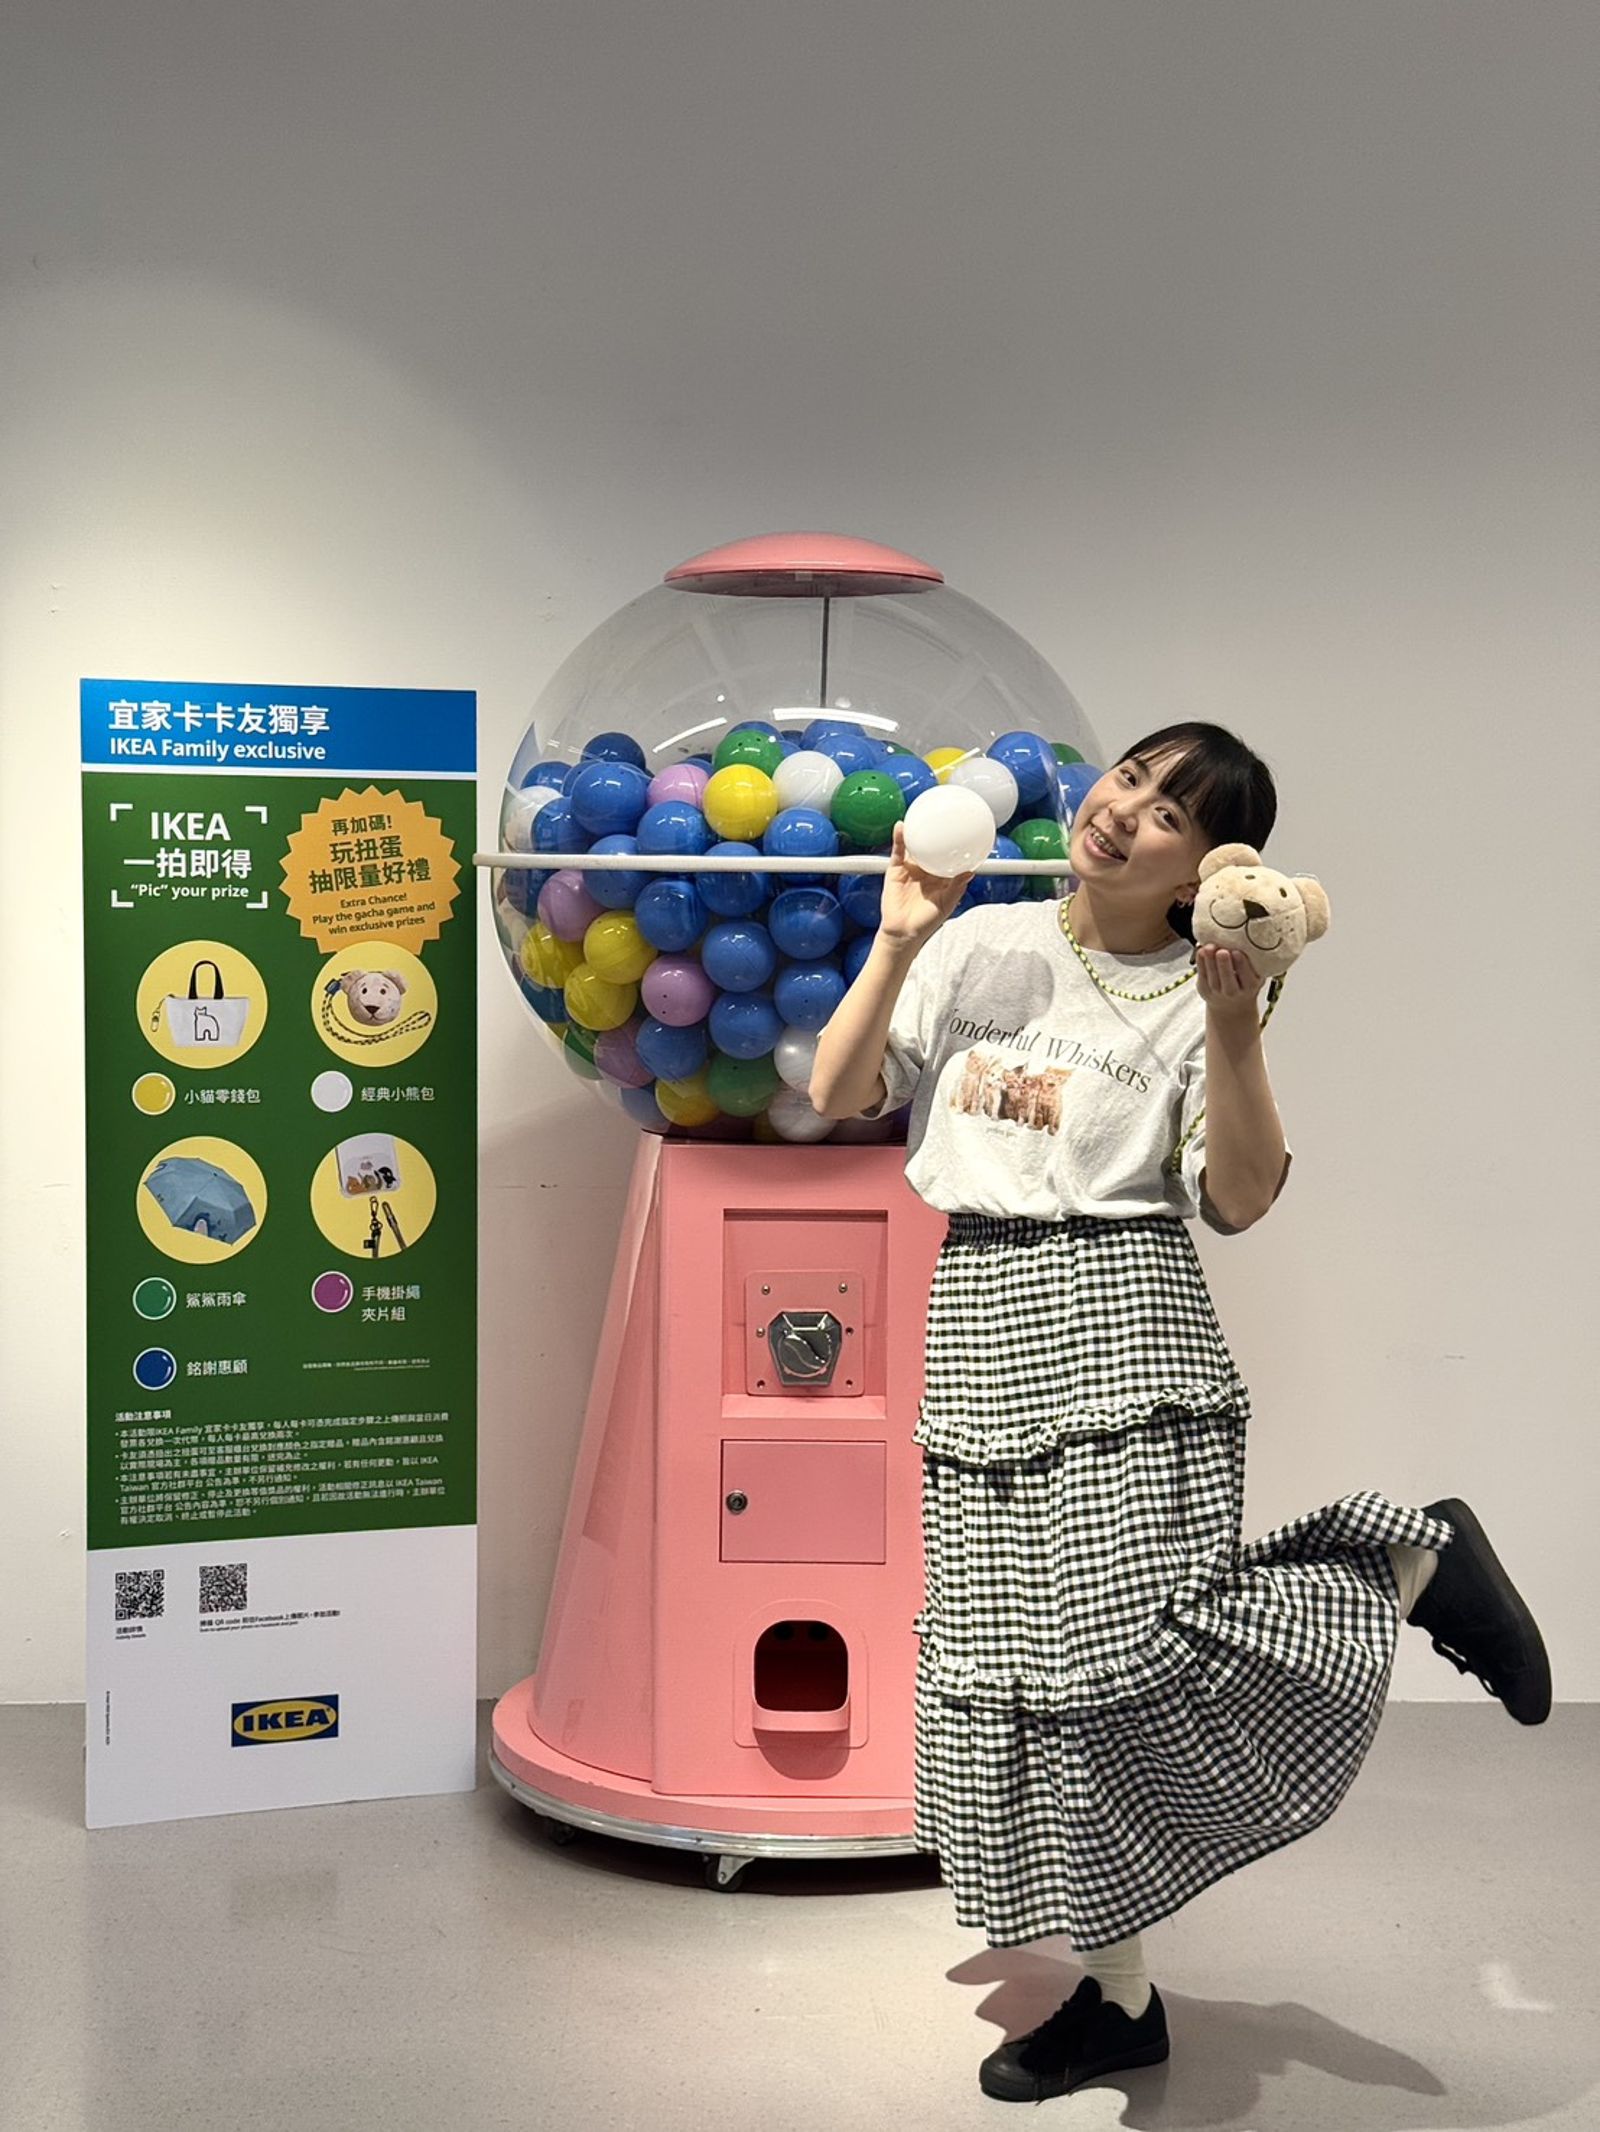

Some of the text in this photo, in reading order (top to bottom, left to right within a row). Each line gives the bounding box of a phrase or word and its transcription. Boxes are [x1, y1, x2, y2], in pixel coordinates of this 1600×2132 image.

[108, 700, 330, 736] 宜家卡卡友獨享
[110, 738, 326, 762] IKEA Family exclusive
[150, 811, 231, 841] IKEA
[331, 814, 392, 836] 再加碼!
[329, 835, 403, 864] 玩扭蛋
[124, 848, 252, 880] 一拍即得
[308, 858, 431, 894] 抽限量好禮
[171, 886, 208, 901] your
[211, 884, 249, 901] prize
[340, 893, 407, 908] Extra Chance!
[312, 901, 435, 926] Play the gacha game and
[328, 916, 425, 935] win exclusive prizes
[1047, 1038, 1151, 1093] Whiskers
[184, 1088, 261, 1105] 小貓零錢包
[361, 1086, 435, 1102] 經典小熊包
[185, 1291, 247, 1309] 鯊鯊雨傘
[362, 1284, 420, 1302] 手機掛繩
[361, 1306, 406, 1323] 夾片組
[186, 1359, 248, 1377] 銘謝惠顧
[243, 1708, 331, 1732] IKEA
